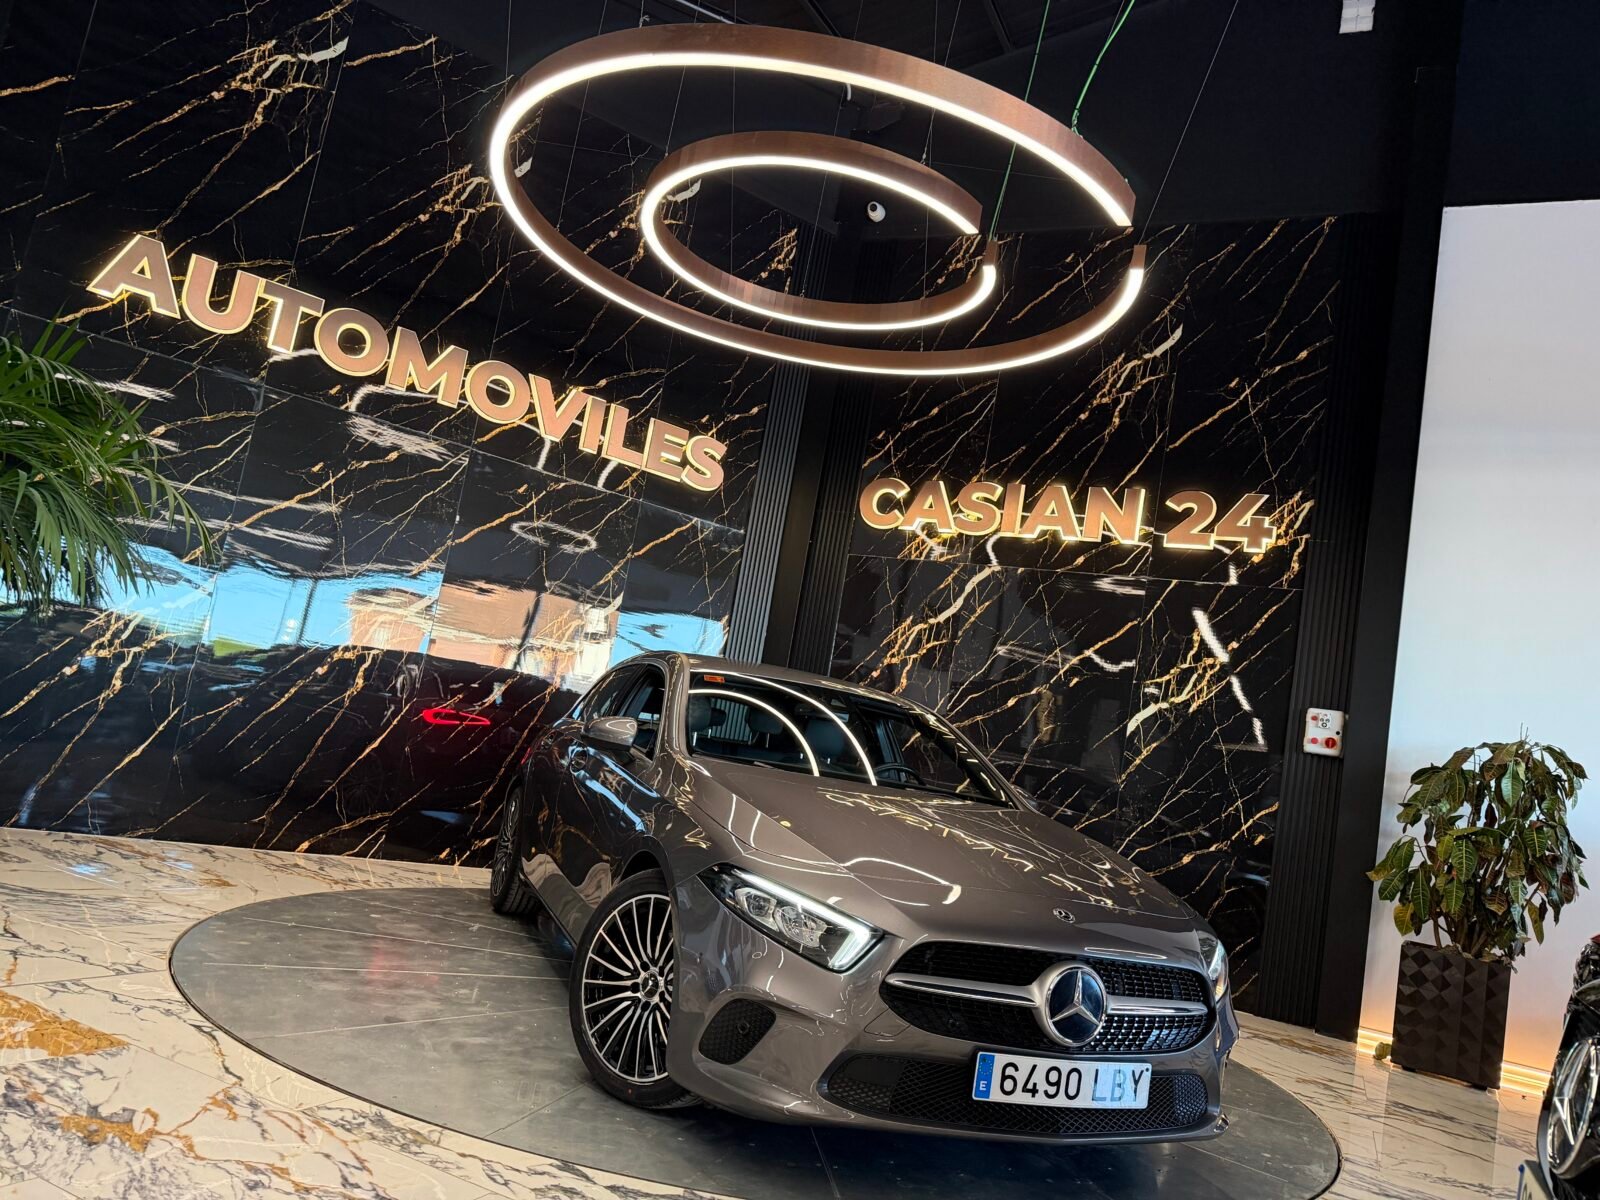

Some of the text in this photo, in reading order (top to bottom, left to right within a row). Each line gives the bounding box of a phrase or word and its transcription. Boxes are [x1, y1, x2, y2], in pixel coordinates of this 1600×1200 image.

[86, 233, 728, 492] AUTOMOVILES
[858, 477, 1277, 553] CASIAN 24
[979, 1062, 1144, 1102] E 6490 LBY
